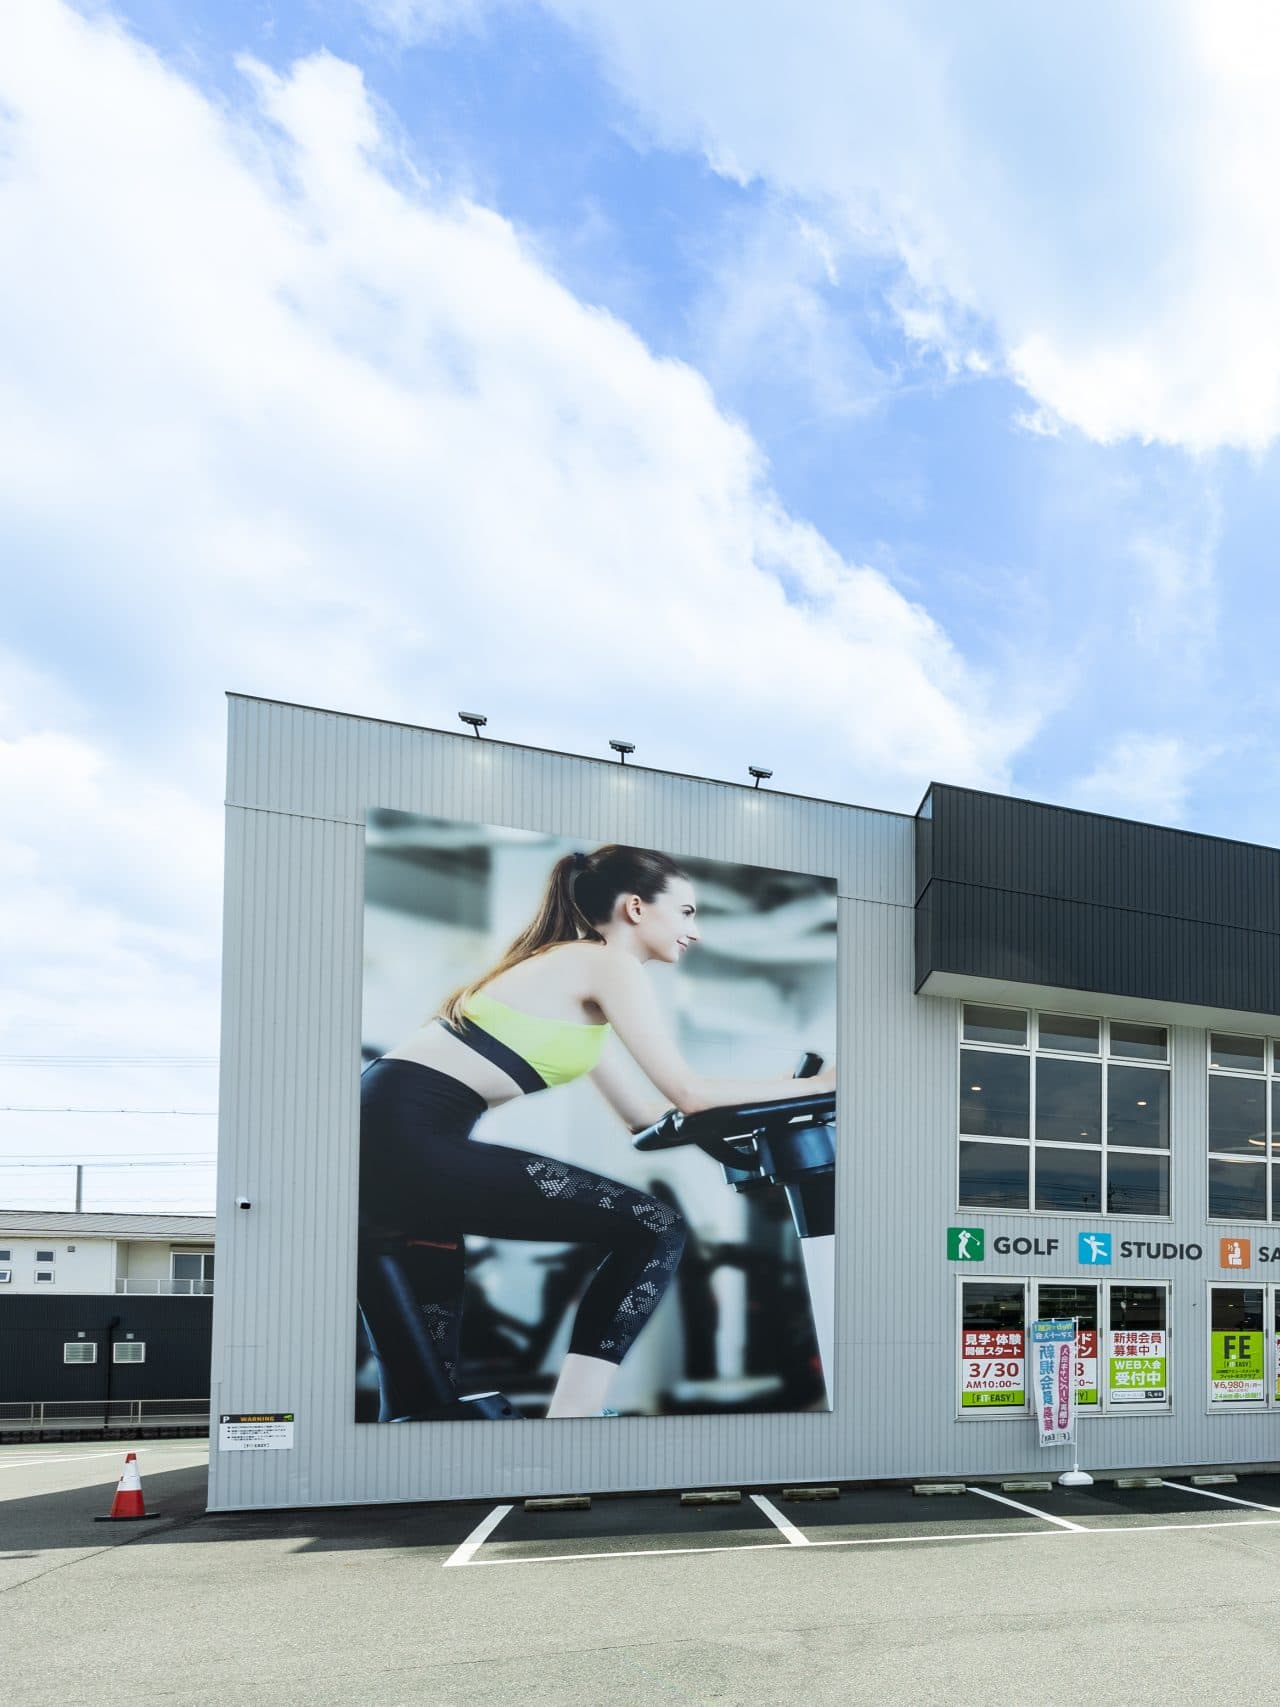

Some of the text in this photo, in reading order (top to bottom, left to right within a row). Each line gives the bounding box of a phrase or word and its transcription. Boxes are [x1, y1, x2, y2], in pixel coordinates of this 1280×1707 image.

[993, 1236, 1059, 1256] GOLF
[1120, 1240, 1203, 1261] STUDIO
[1114, 1332, 1162, 1344] 新規会員
[969, 1362, 1019, 1378] 3/30
[1115, 1371, 1161, 1386] 受付中
